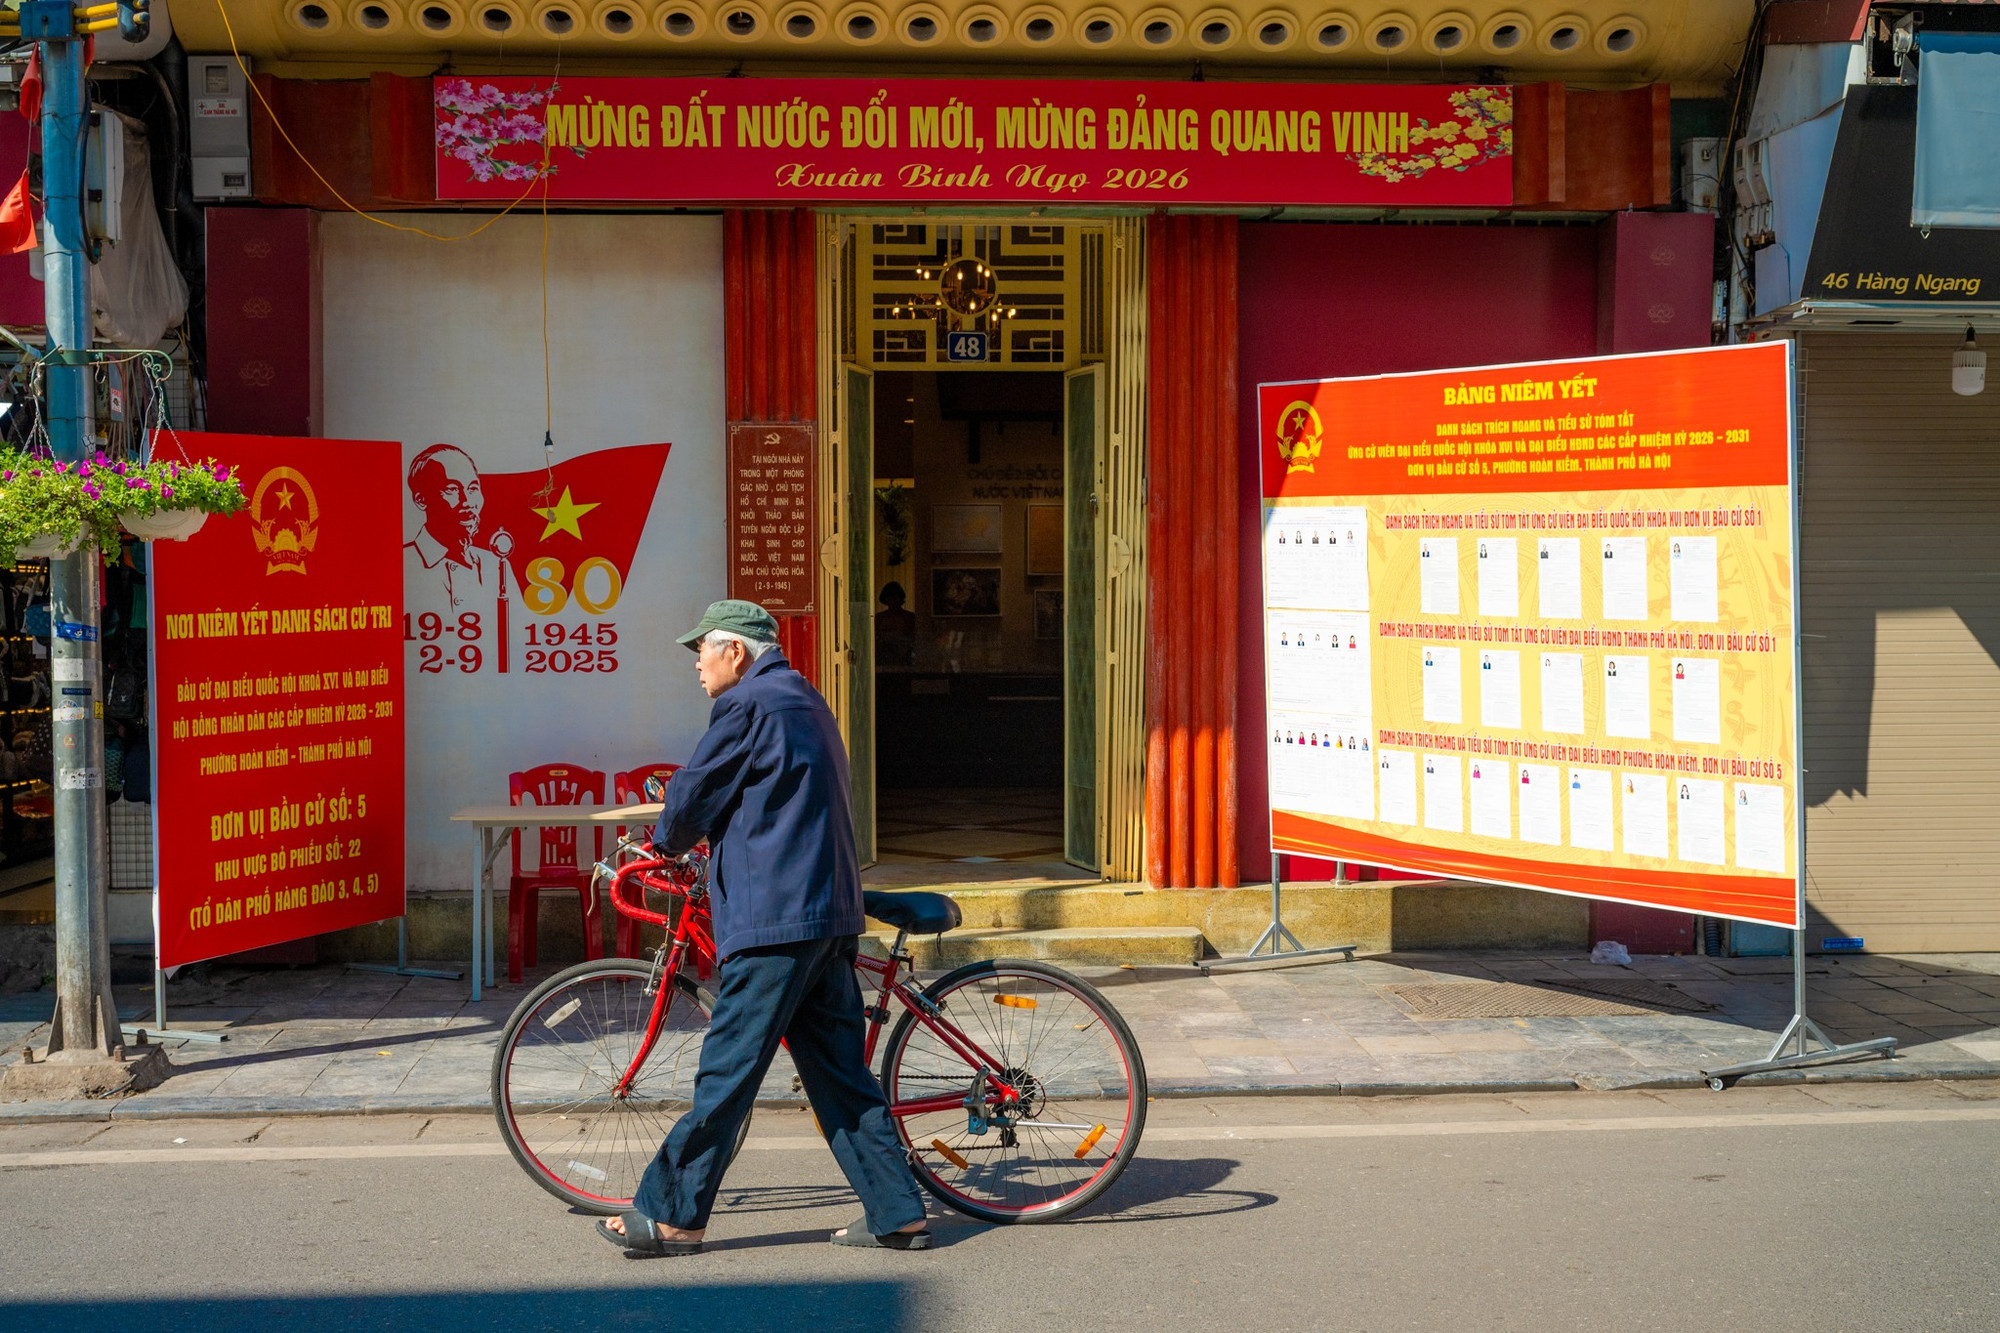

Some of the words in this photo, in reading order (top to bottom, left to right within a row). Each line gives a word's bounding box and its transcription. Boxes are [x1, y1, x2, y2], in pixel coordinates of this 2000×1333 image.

[547, 95, 649, 149] MỪNG
[661, 90, 725, 148] ĐẤT
[738, 96, 829, 148] NƯỚC
[841, 88, 896, 149] ĐỔI
[910, 97, 983, 154] MỚI,
[996, 98, 1096, 150] MỪNG
[1107, 94, 1198, 151] ĐẢNG
[1211, 107, 1320, 156] QUANG
[1332, 111, 1409, 153] VINH
[775, 163, 882, 187] Xuân
[1005, 165, 1087, 193] Ngọ
[1102, 168, 1188, 189] 2026
[1822, 272, 1849, 289] 46
[1856, 272, 1909, 295] Hàng
[1915, 273, 1981, 296] Ngang
[954, 336, 980, 357] 48
[1444, 382, 1496, 405] BẢNG
[1500, 379, 1554, 402] NIÊM
[1558, 372, 1597, 399] YẾT
[1436, 423, 1458, 436] DANH
[1460, 422, 1483, 435] SÁCH
[1484, 420, 1510, 434] TRÍCH
[1512, 419, 1541, 433] NGANG
[1557, 412, 1577, 431] TIỂU
[1579, 413, 1592, 430] SỬ
[1594, 413, 1615, 429] TÓM
[1617, 409, 1634, 427] TẮT
[1407, 463, 1424, 476] ĐƠN
[1436, 459, 1453, 476] BẦU
[1455, 459, 1467, 475] CỬ
[1468, 458, 1480, 475] SỐ
[1492, 459, 1527, 474] PHƯỜNG
[1529, 458, 1553, 473] HOÀN
[1584, 455, 1614, 471] THÀNH
[1617, 452, 1636, 470] PHỐ
[1638, 453, 1652, 469] HÀ
[1654, 452, 1671, 470] NỘI
[1757, 510, 1762, 526] 1
[523, 556, 622, 616] 80
[166, 614, 194, 640] NƠI
[197, 607, 238, 638] NIÊM
[241, 602, 268, 636] YẾT
[271, 609, 311, 634] DANH
[314, 604, 348, 632] SÁCH
[351, 600, 368, 630] CỬ
[370, 605, 392, 629] TRI
[404, 612, 482, 641] 19-8
[524, 623, 618, 646] 1945
[419, 645, 482, 673] 2-9
[525, 650, 619, 673] 2025
[177, 677, 196, 703] BẦU
[199, 677, 212, 701] CỬ
[214, 680, 230, 702] ĐẠI
[232, 672, 253, 698] BIỂU
[255, 671, 279, 696] QUỐC
[281, 672, 296, 696] HỘI
[323, 672, 339, 690] XVI
[355, 670, 369, 690] ĐẠI
[371, 662, 389, 686] BIỂU
[173, 716, 189, 742] HỘI
[192, 712, 218, 737] ĐỒNG
[220, 711, 245, 734] NHÂN
[247, 709, 265, 731] DÂN
[267, 708, 285, 729] CÁC
[287, 704, 304, 727] CẤP
[305, 704, 333, 727] NHIỆM
[335, 702, 345, 722] KỲ
[347, 703, 367, 721] 2026
[375, 701, 393, 718] 2031
[200, 752, 237, 776] PHƯỜNG
[239, 749, 263, 771] HOÀN
[265, 743, 288, 768] KIẾM
[298, 742, 325, 764] THÀNH
[327, 736, 343, 760] PHỐ
[345, 738, 356, 758] HÀ
[358, 736, 372, 758] NỘI
[210, 811, 244, 841] ĐƠN
[249, 808, 264, 839] VỊ
[270, 796, 300, 832] BẦU
[305, 793, 325, 826] CỬ
[329, 787, 352, 822] SỐ:
[358, 794, 366, 818] 5
[215, 859, 240, 882] KHU
[243, 853, 267, 879] VỰC
[270, 845, 286, 872] BỎ
[290, 839, 322, 868] PHIẾU
[325, 835, 343, 862] SỐ:
[348, 838, 361, 858] 22
[215, 897, 241, 924] DÂN
[246, 886, 271, 918] PHỐ
[275, 886, 307, 912] HÀNG
[311, 879, 335, 905] ĐÀO
